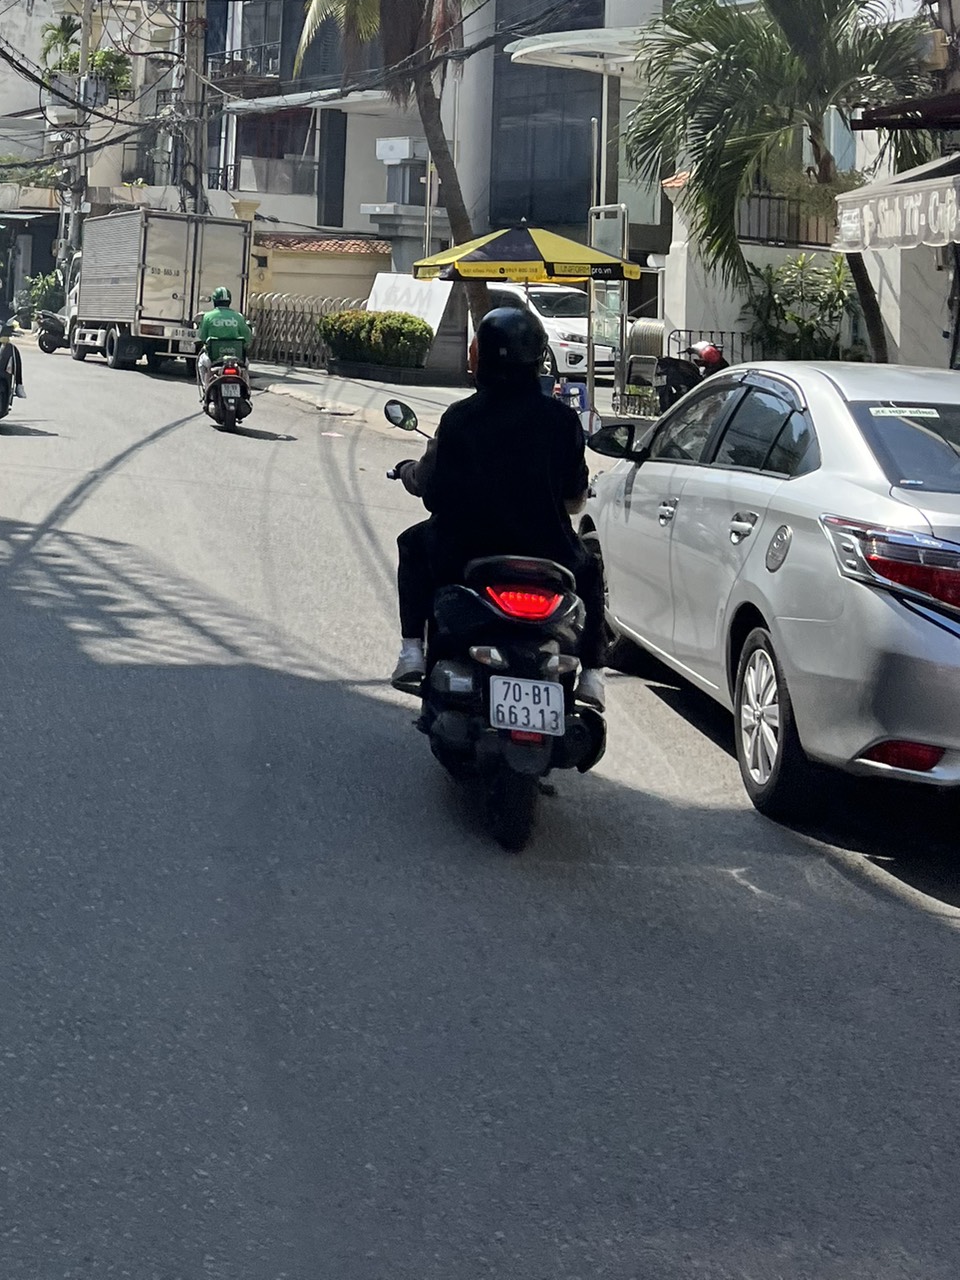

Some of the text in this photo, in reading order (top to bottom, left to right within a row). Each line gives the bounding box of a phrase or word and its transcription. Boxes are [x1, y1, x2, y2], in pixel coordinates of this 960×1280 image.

[213, 316, 238, 327] Grab
[502, 681, 550, 706] 70-B1
[496, 703, 559, 730] 663.13
